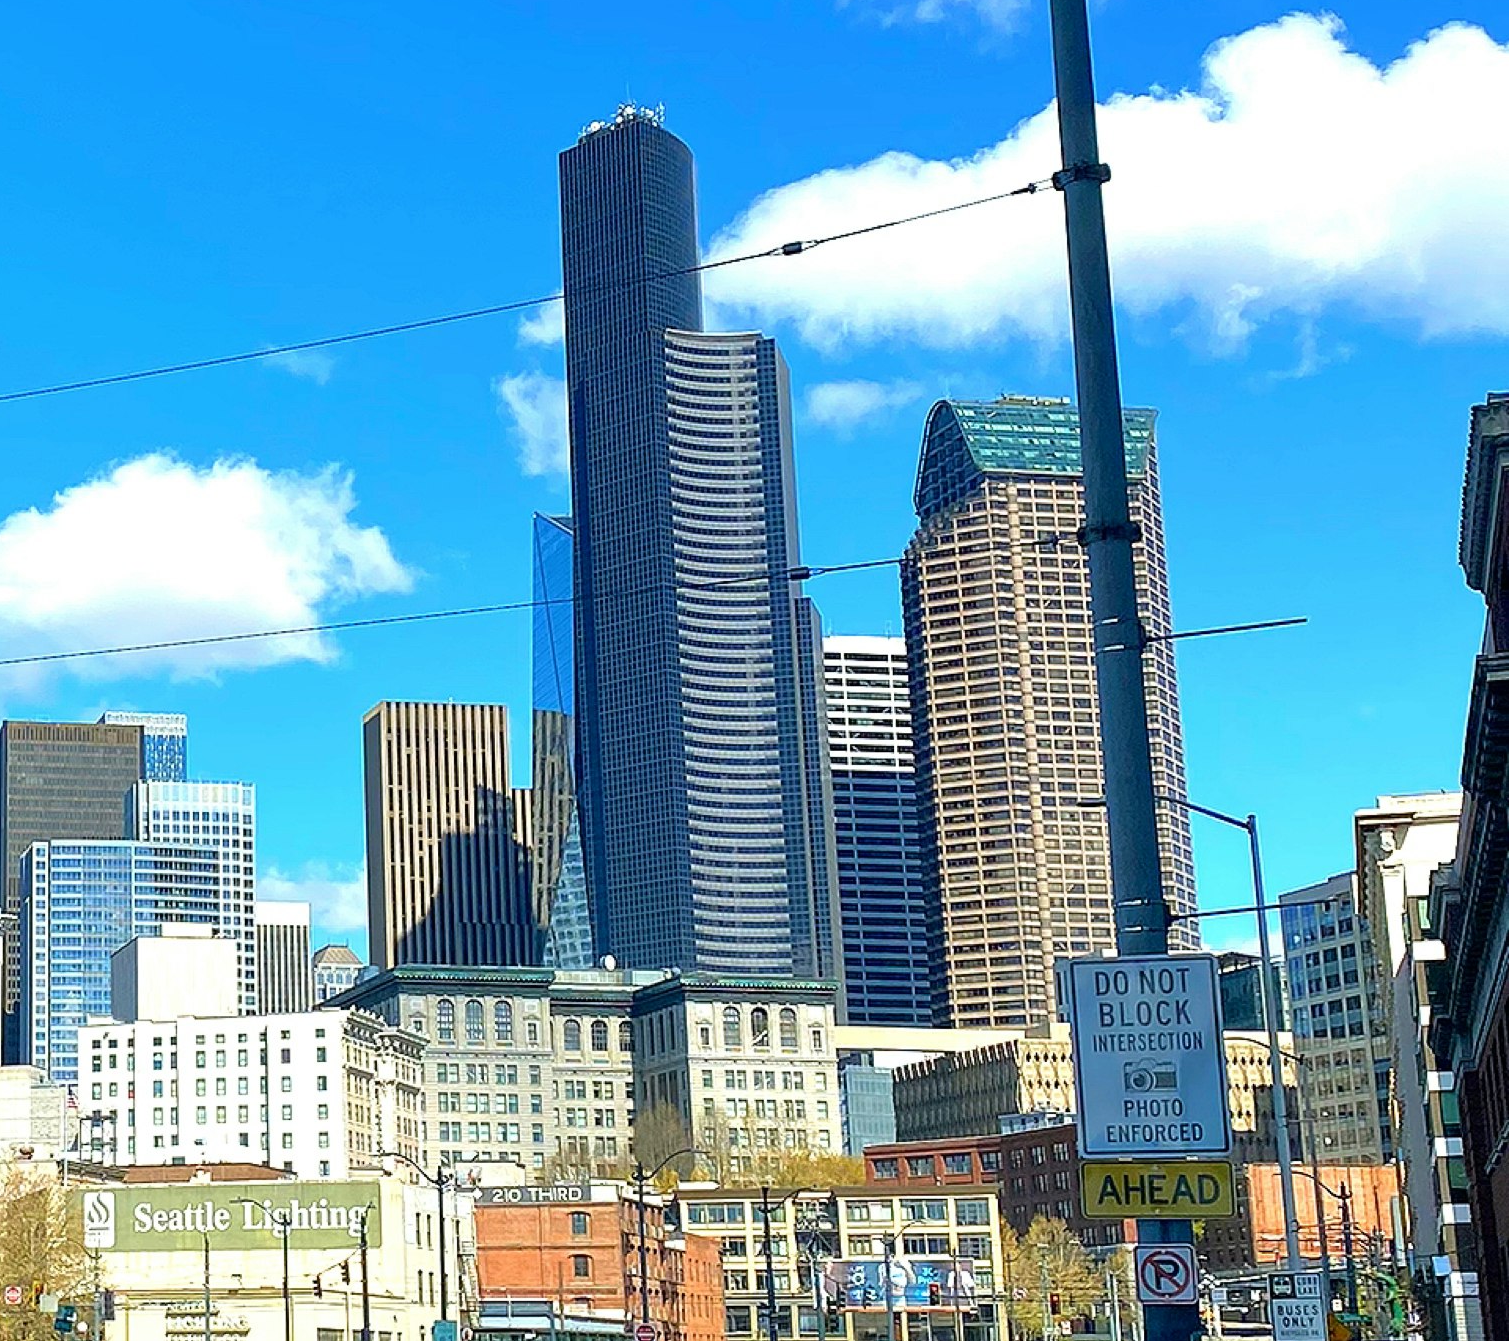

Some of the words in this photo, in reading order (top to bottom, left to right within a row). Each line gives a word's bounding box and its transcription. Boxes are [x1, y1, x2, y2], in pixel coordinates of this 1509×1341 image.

[1094, 970, 1128, 996] DO
[1139, 967, 1191, 994] NOT
[1099, 1000, 1192, 1027] BLOCK
[1092, 1031, 1204, 1052] INTERSECTION
[1123, 1097, 1184, 1119] PHOTO
[1105, 1122, 1204, 1144] ENFORCED
[492, 1188, 522, 1203] 210
[527, 1187, 582, 1202] THIRD
[1097, 1173, 1221, 1207] AHEAD
[133, 1198, 231, 1234] Seattle
[242, 1196, 367, 1240] Lighting
[1277, 1305, 1319, 1316] BUSES
[1282, 1316, 1315, 1328] ONLY
